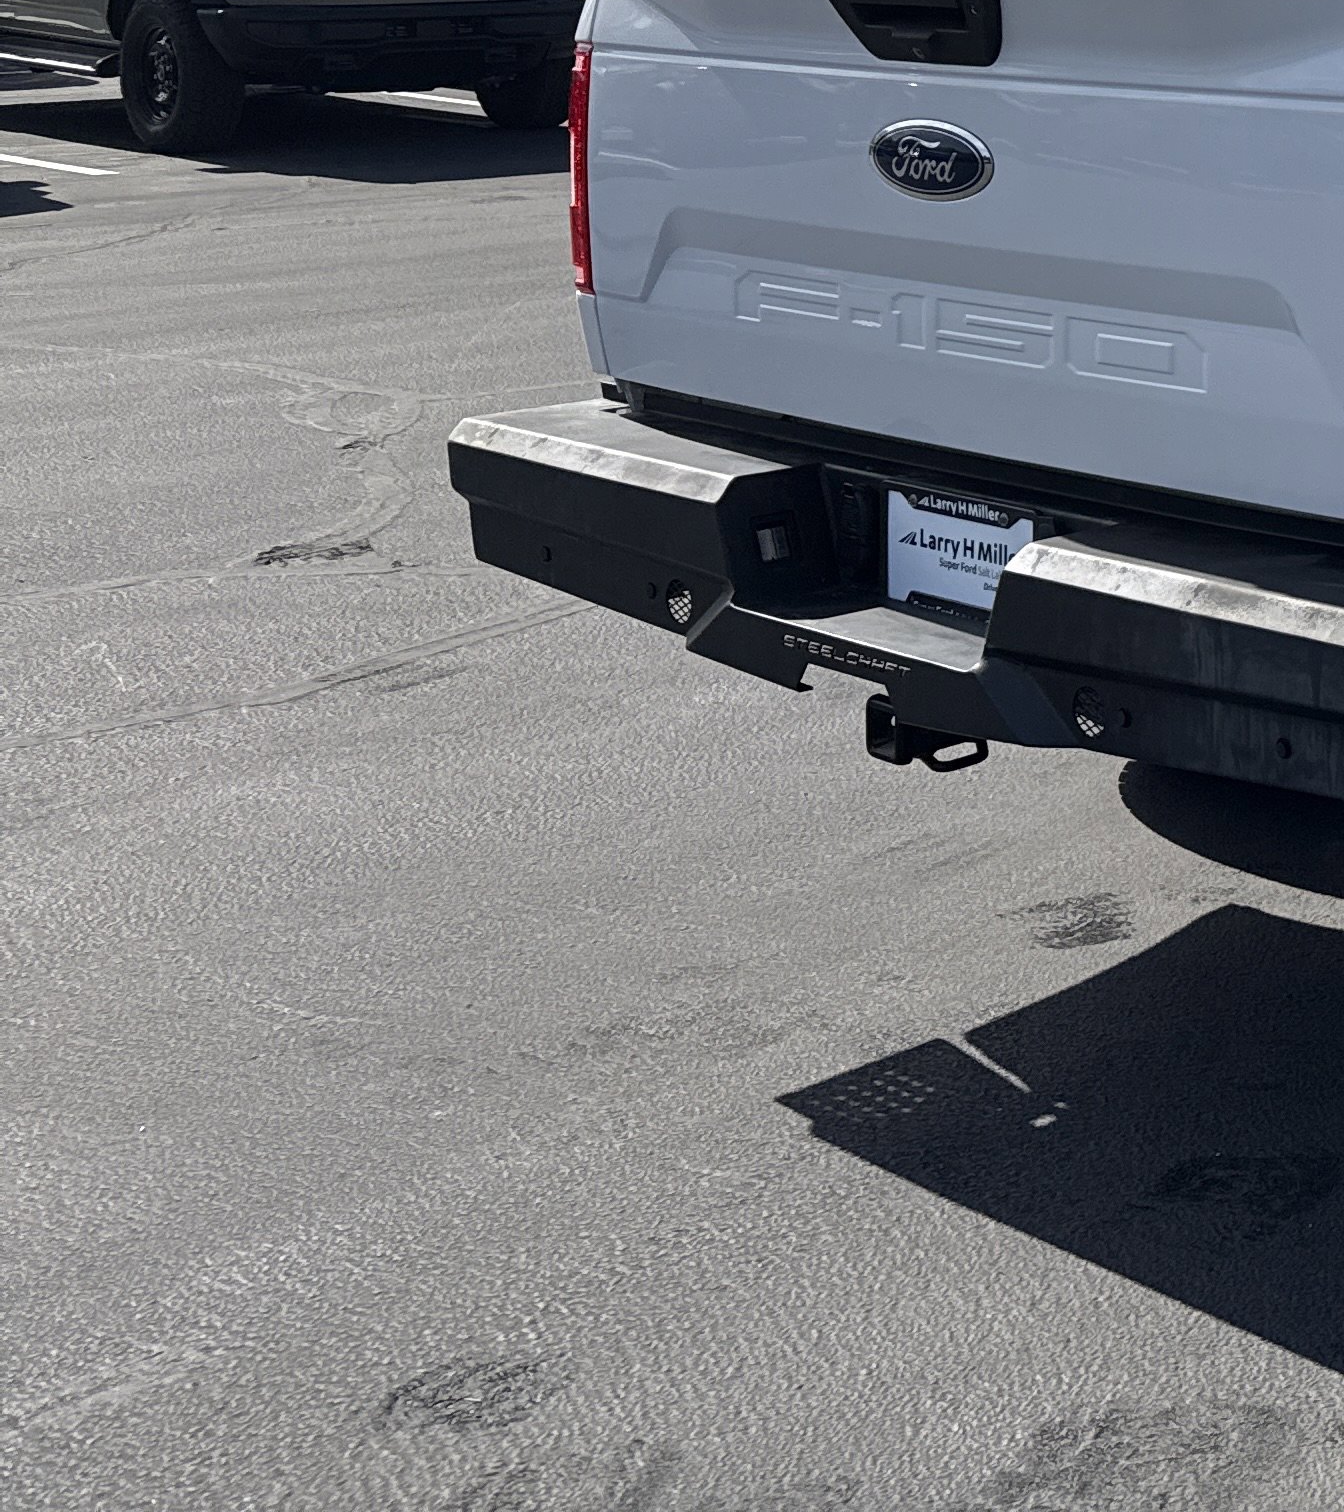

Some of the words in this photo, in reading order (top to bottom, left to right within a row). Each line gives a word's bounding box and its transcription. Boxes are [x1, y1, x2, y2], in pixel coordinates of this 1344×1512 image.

[891, 135, 958, 184] Ford
[734, 269, 1208, 394] F-150
[930, 495, 957, 515] Larry
[958, 500, 967, 515] H
[967, 502, 1000, 522] Miller
[920, 528, 960, 560] Larry
[963, 537, 975, 560] H
[960, 562, 977, 575] Ford
